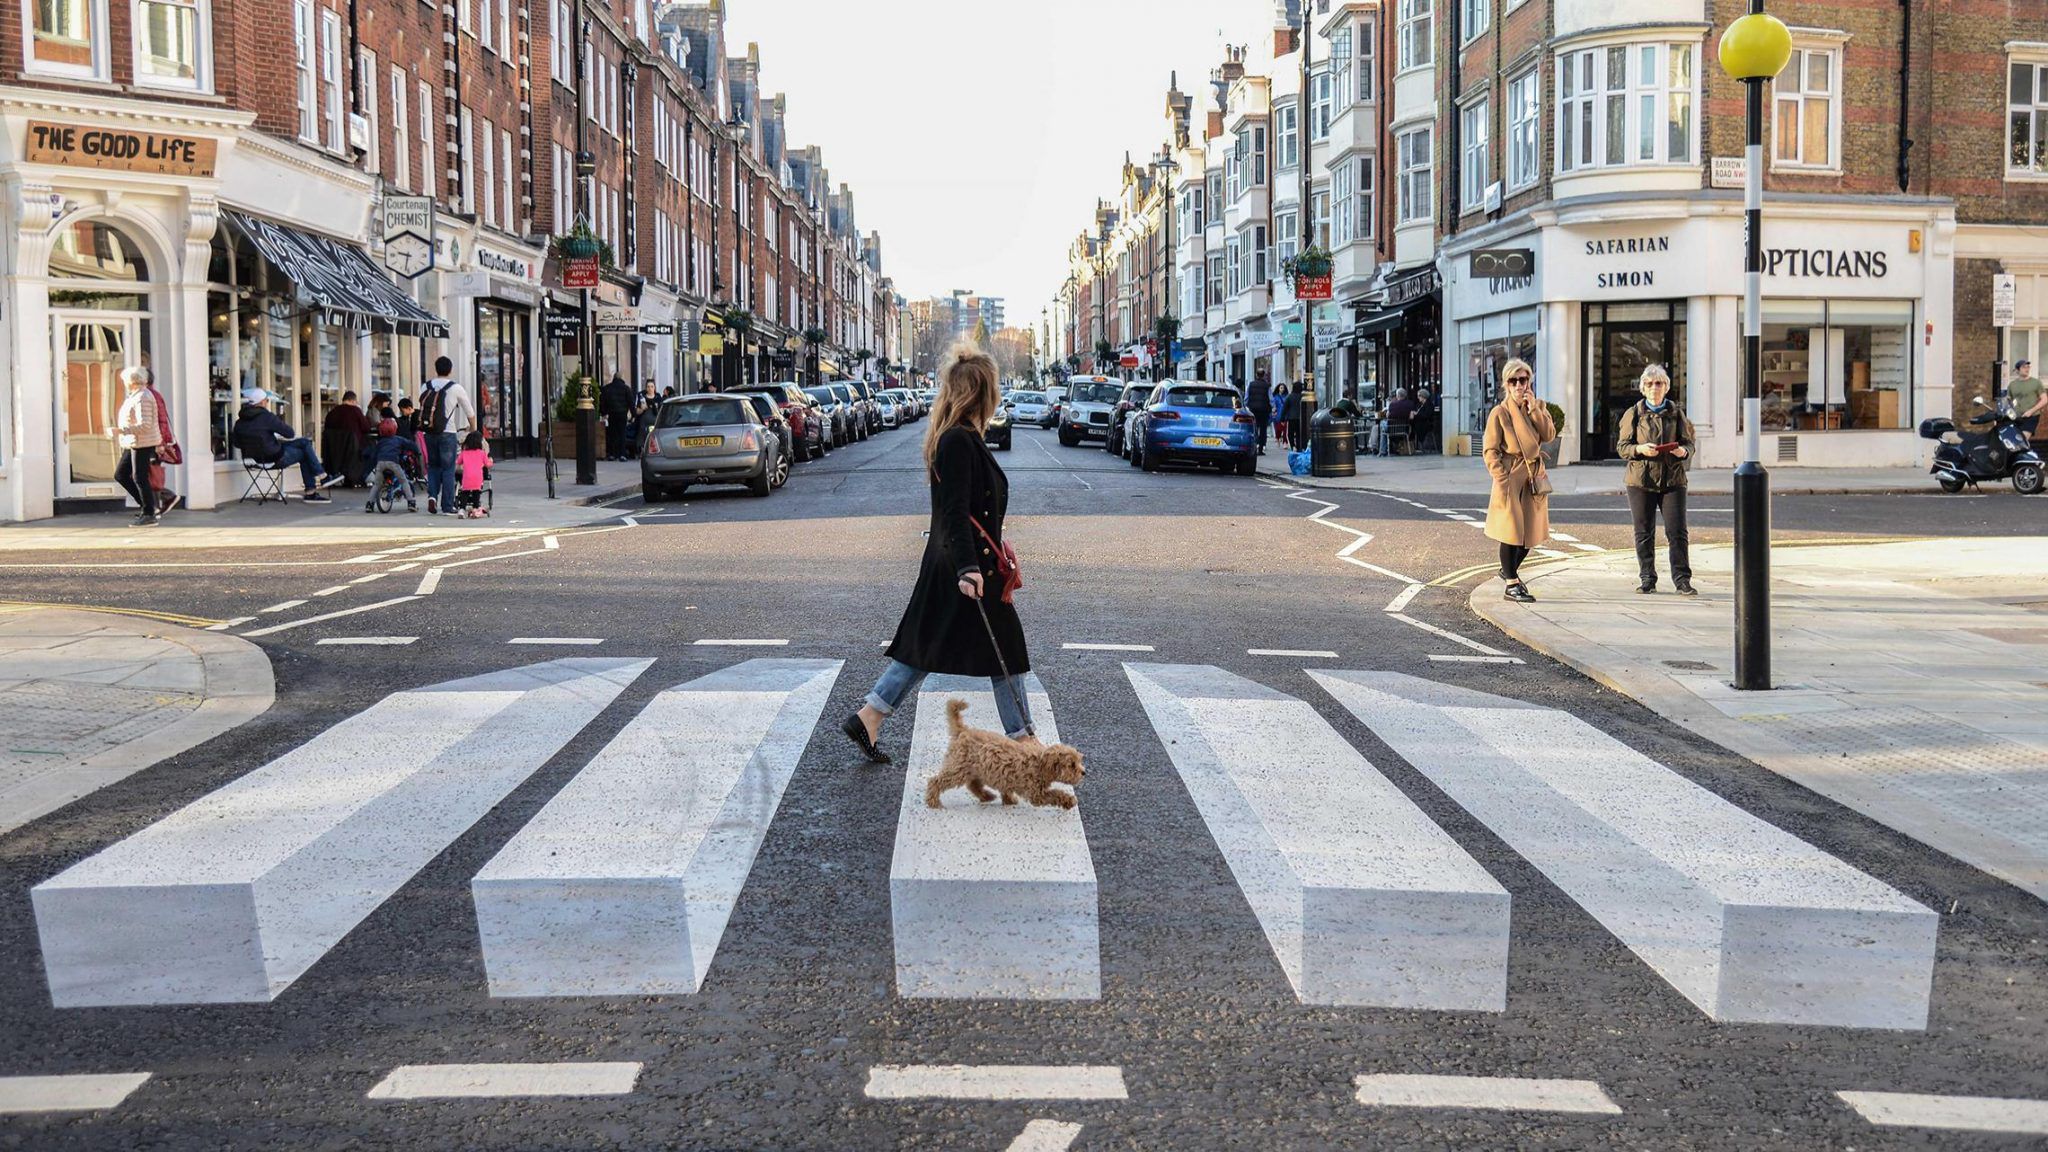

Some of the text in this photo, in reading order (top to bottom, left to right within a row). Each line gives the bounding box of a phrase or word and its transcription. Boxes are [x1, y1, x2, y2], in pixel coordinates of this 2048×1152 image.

[33, 126, 75, 151] THE
[82, 131, 140, 160] GOOD
[1715, 160, 1741, 169] BARROW
[1715, 169, 1732, 178] ROAD
[386, 198, 428, 212] Courtenay
[386, 212, 429, 229] CHEMIST
[1586, 237, 1669, 256] SAFARIAN
[1597, 270, 1654, 288] SIMON
[599, 311, 636, 324] Sahara
